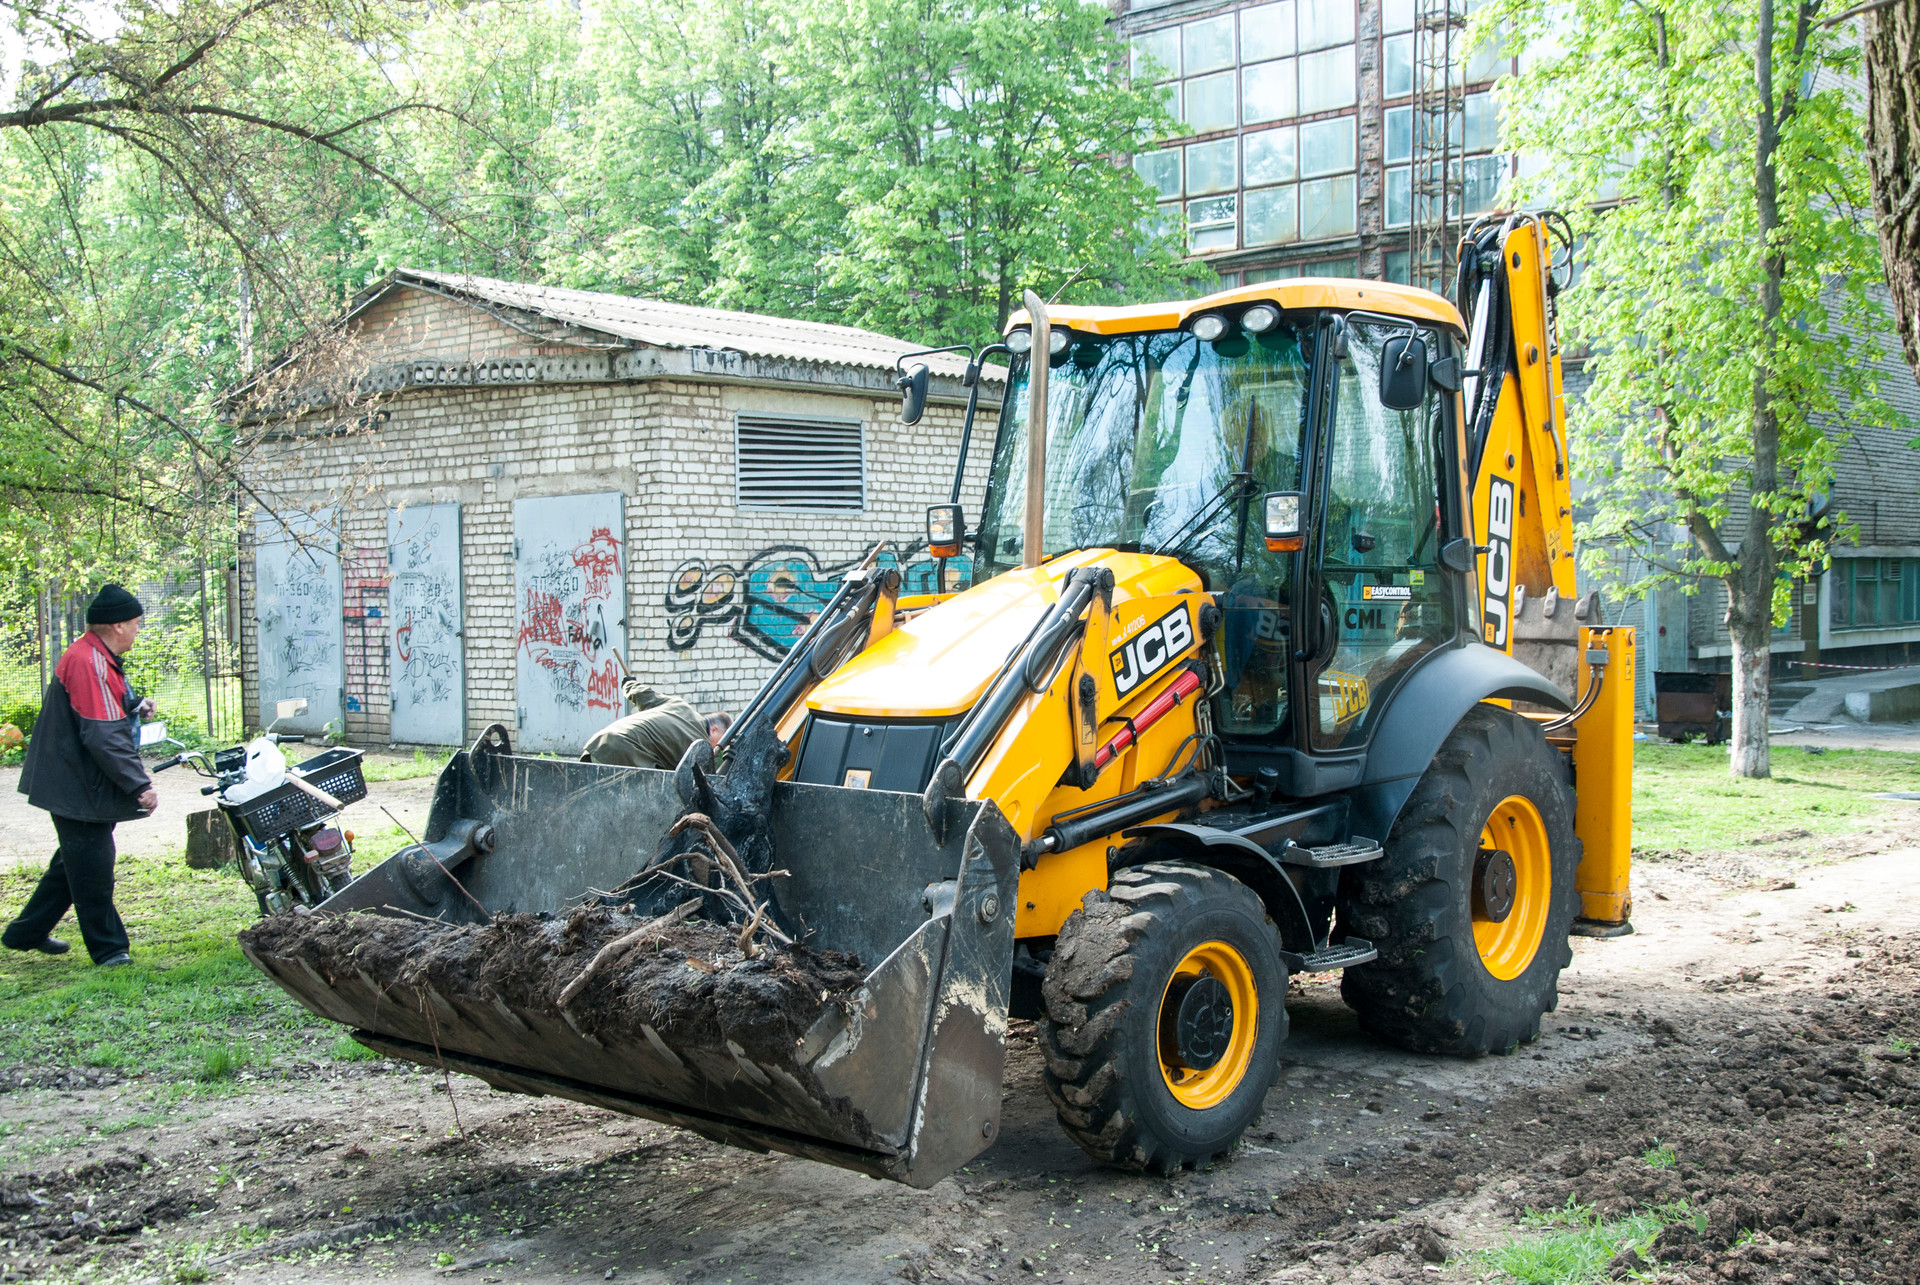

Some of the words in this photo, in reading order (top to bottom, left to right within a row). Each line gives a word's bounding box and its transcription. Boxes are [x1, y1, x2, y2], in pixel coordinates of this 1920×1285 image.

[1485, 481, 1512, 646] JCB
[274, 582, 309, 597] ТП-360
[1371, 586, 1411, 598] EASYCONTROL
[1344, 607, 1386, 630] CML
[1115, 607, 1192, 693] JCB
[1335, 676, 1368, 719] JCB
